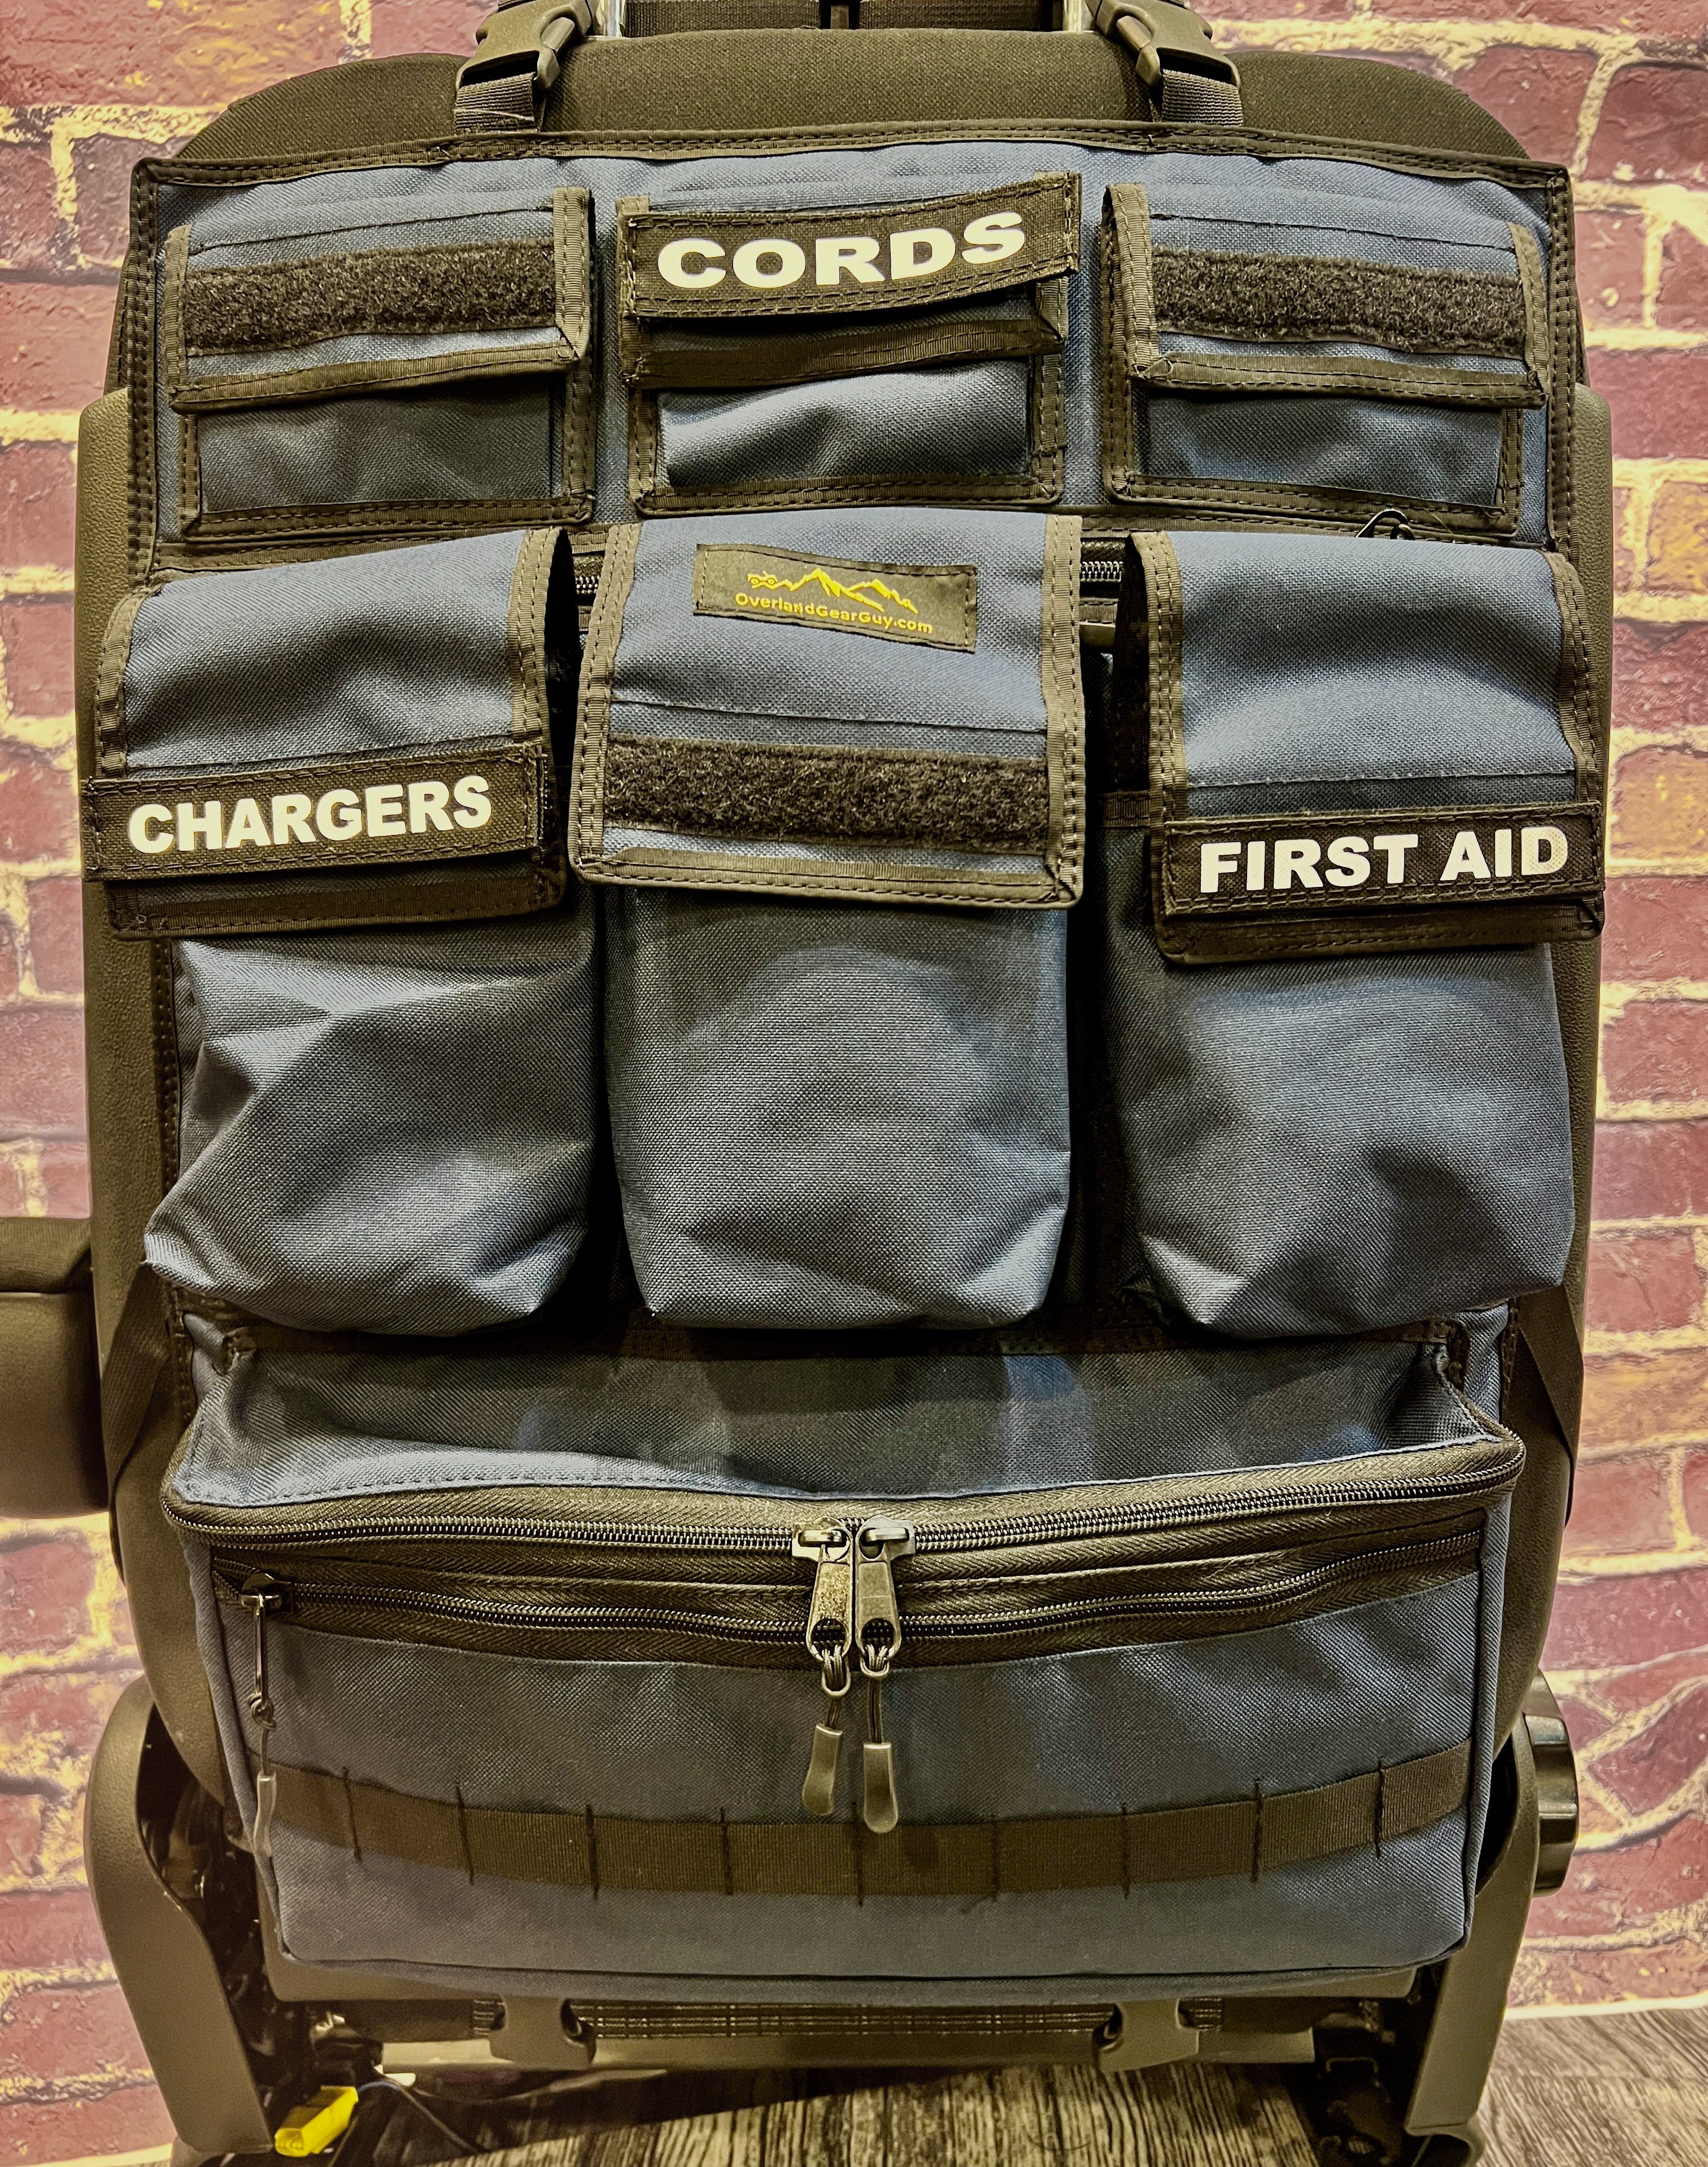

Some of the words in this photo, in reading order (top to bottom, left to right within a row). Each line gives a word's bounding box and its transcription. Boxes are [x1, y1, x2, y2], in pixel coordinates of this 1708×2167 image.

[657, 211, 1026, 289] CORDS
[735, 592, 933, 633] OverlandGearGuy.com
[128, 775, 493, 854] CHARGERS
[1199, 833, 1419, 894] FIRST
[1439, 826, 1568, 881] AID
